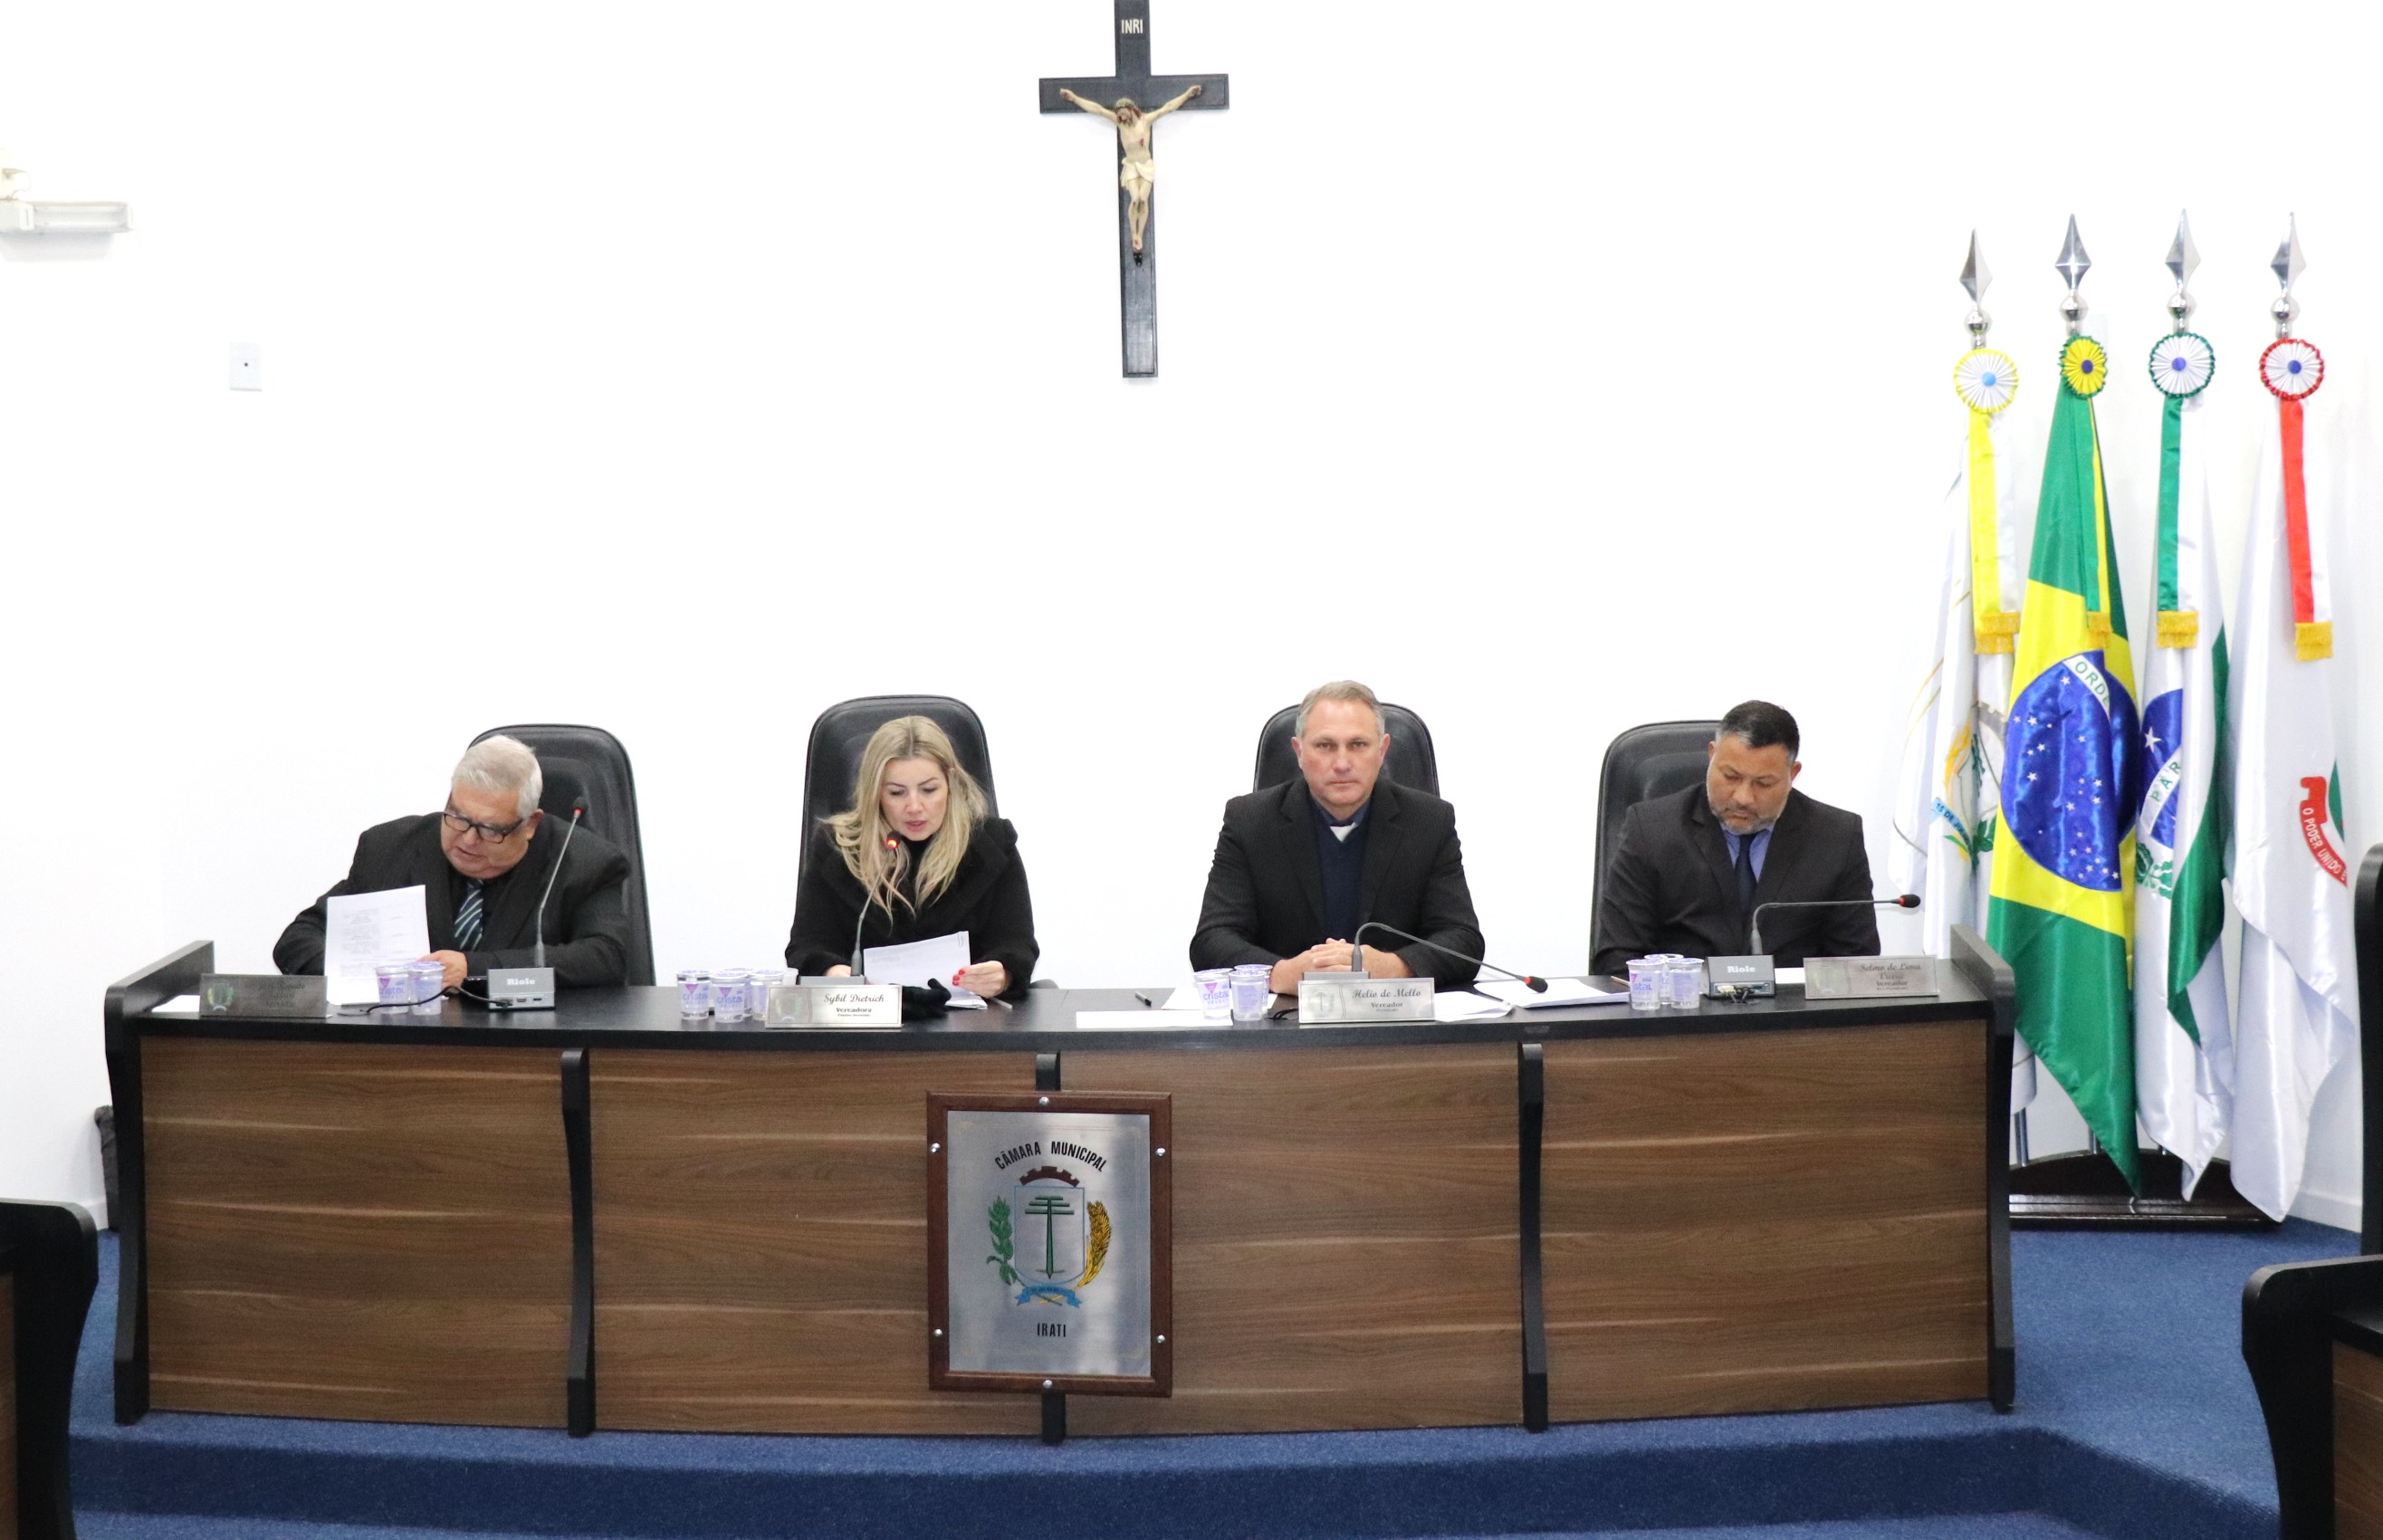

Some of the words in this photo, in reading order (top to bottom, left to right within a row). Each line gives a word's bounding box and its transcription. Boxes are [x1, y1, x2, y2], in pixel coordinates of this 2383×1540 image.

[1121, 19, 1144, 34] INRI
[2302, 808, 2314, 816] O
[2304, 818, 2323, 849] PODER
[2318, 848, 2342, 875] UNIDO
[1727, 965, 1756, 973] Riole
[507, 978, 536, 986] Riole
[824, 993, 847, 1005] Sybil
[849, 993, 885, 1003] Dietrich
[1380, 989, 1391, 998] de
[1394, 989, 1421, 998] Mello
[994, 1142, 1041, 1170] CÂMARA
[1050, 1141, 1107, 1172] MUNICIPAL
[1037, 1323, 1066, 1337] IRATI
